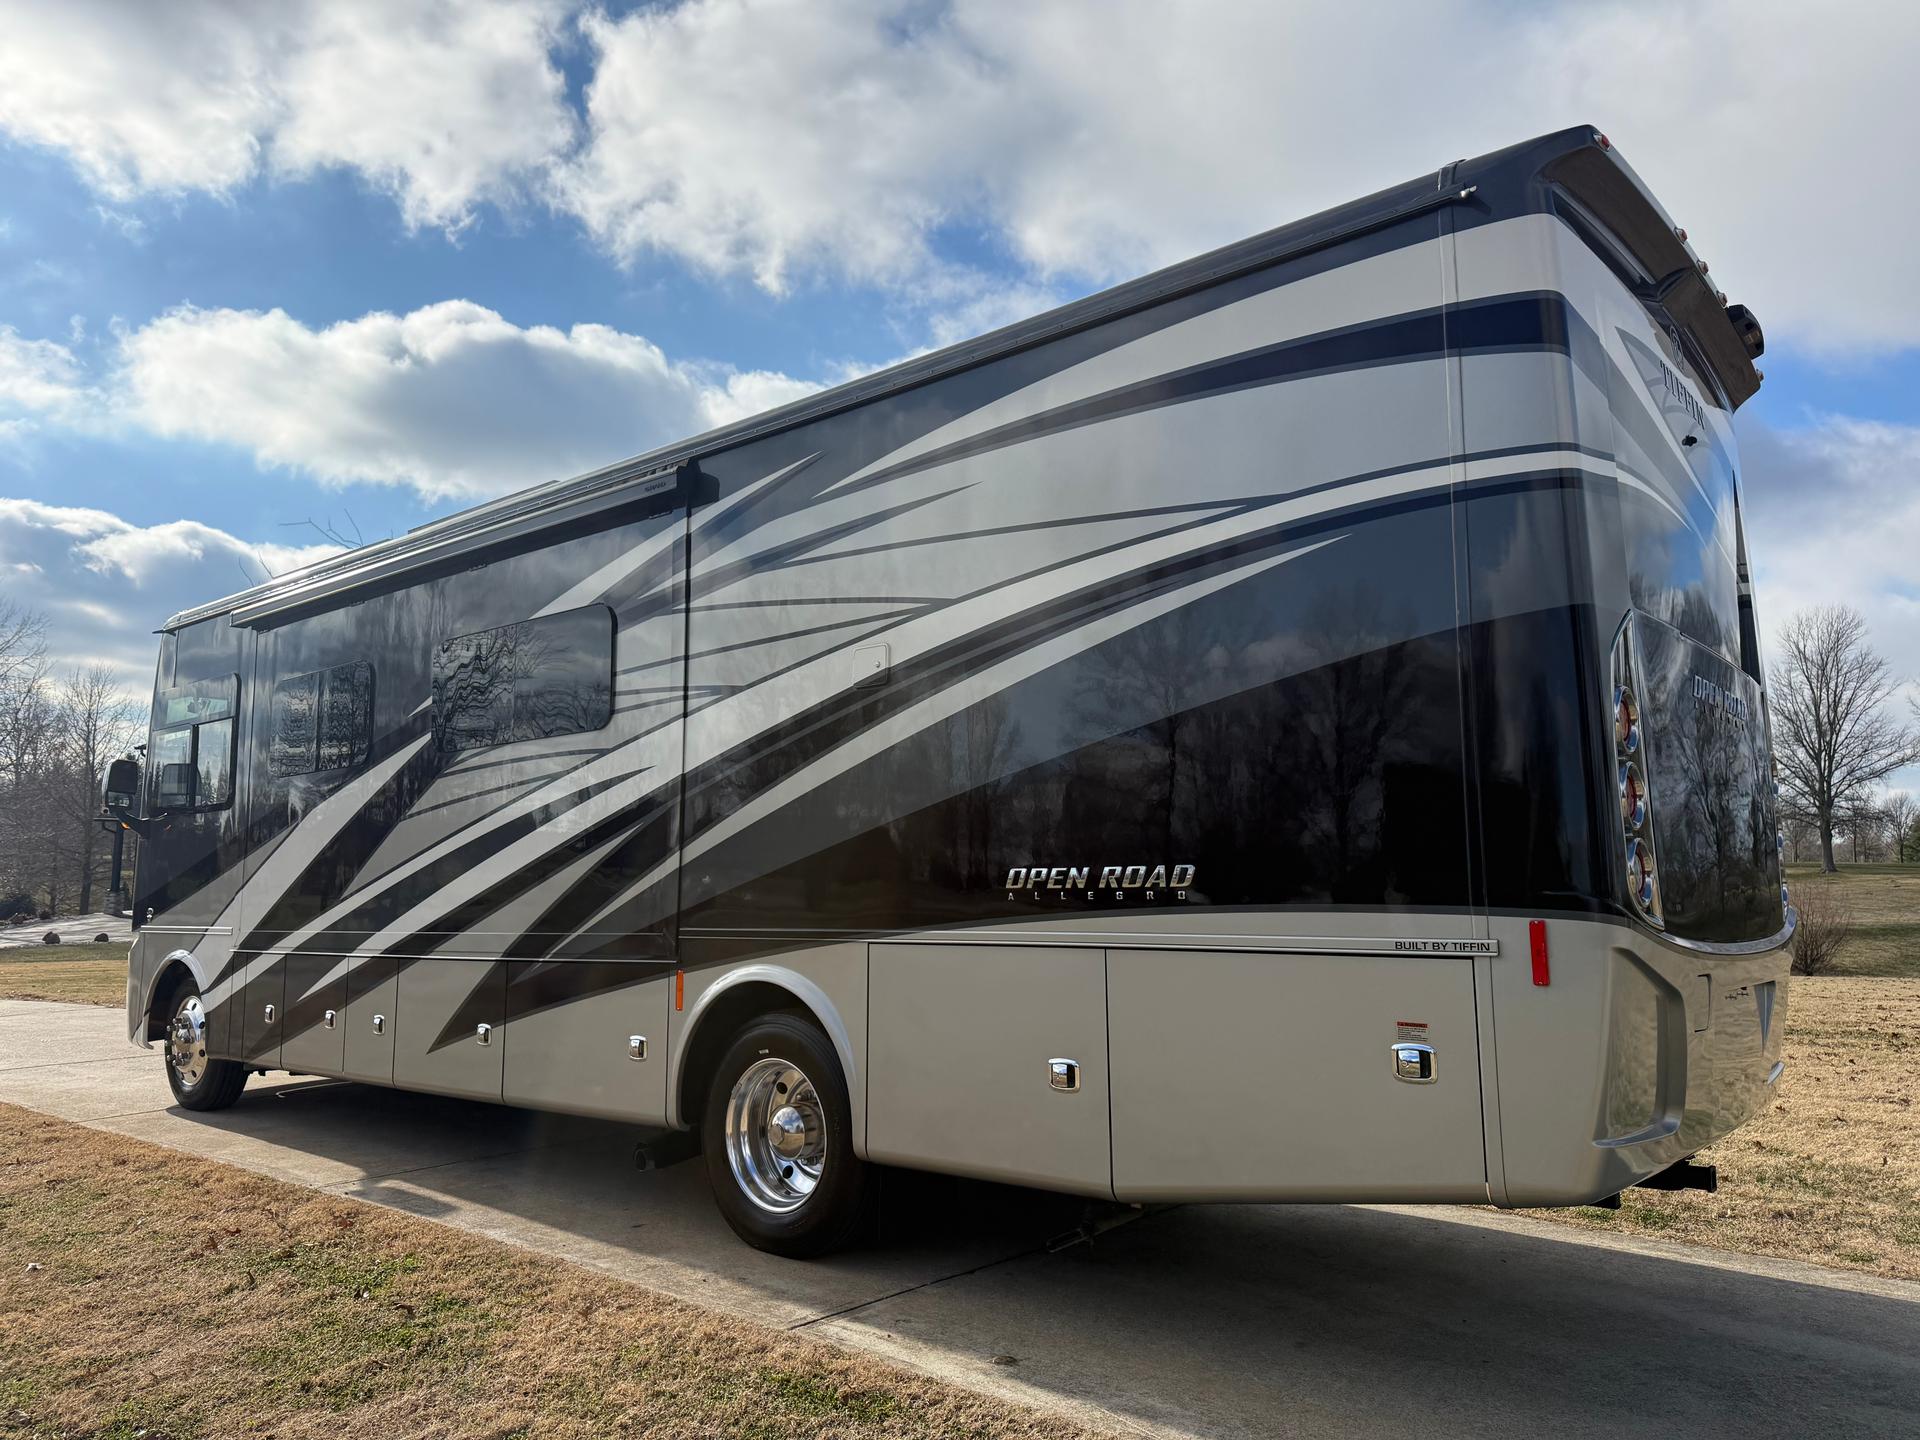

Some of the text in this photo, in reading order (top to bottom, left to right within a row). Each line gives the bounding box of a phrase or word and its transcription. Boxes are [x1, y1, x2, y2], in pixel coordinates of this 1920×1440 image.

[1660, 359, 1705, 430] TIFFIN
[1693, 674, 1723, 707] OPEN
[1005, 864, 1196, 889] OPEN ROAD
[1008, 891, 1186, 900] ALLEGRO
[1395, 941, 1490, 951] BUILT BY TIFFIN
